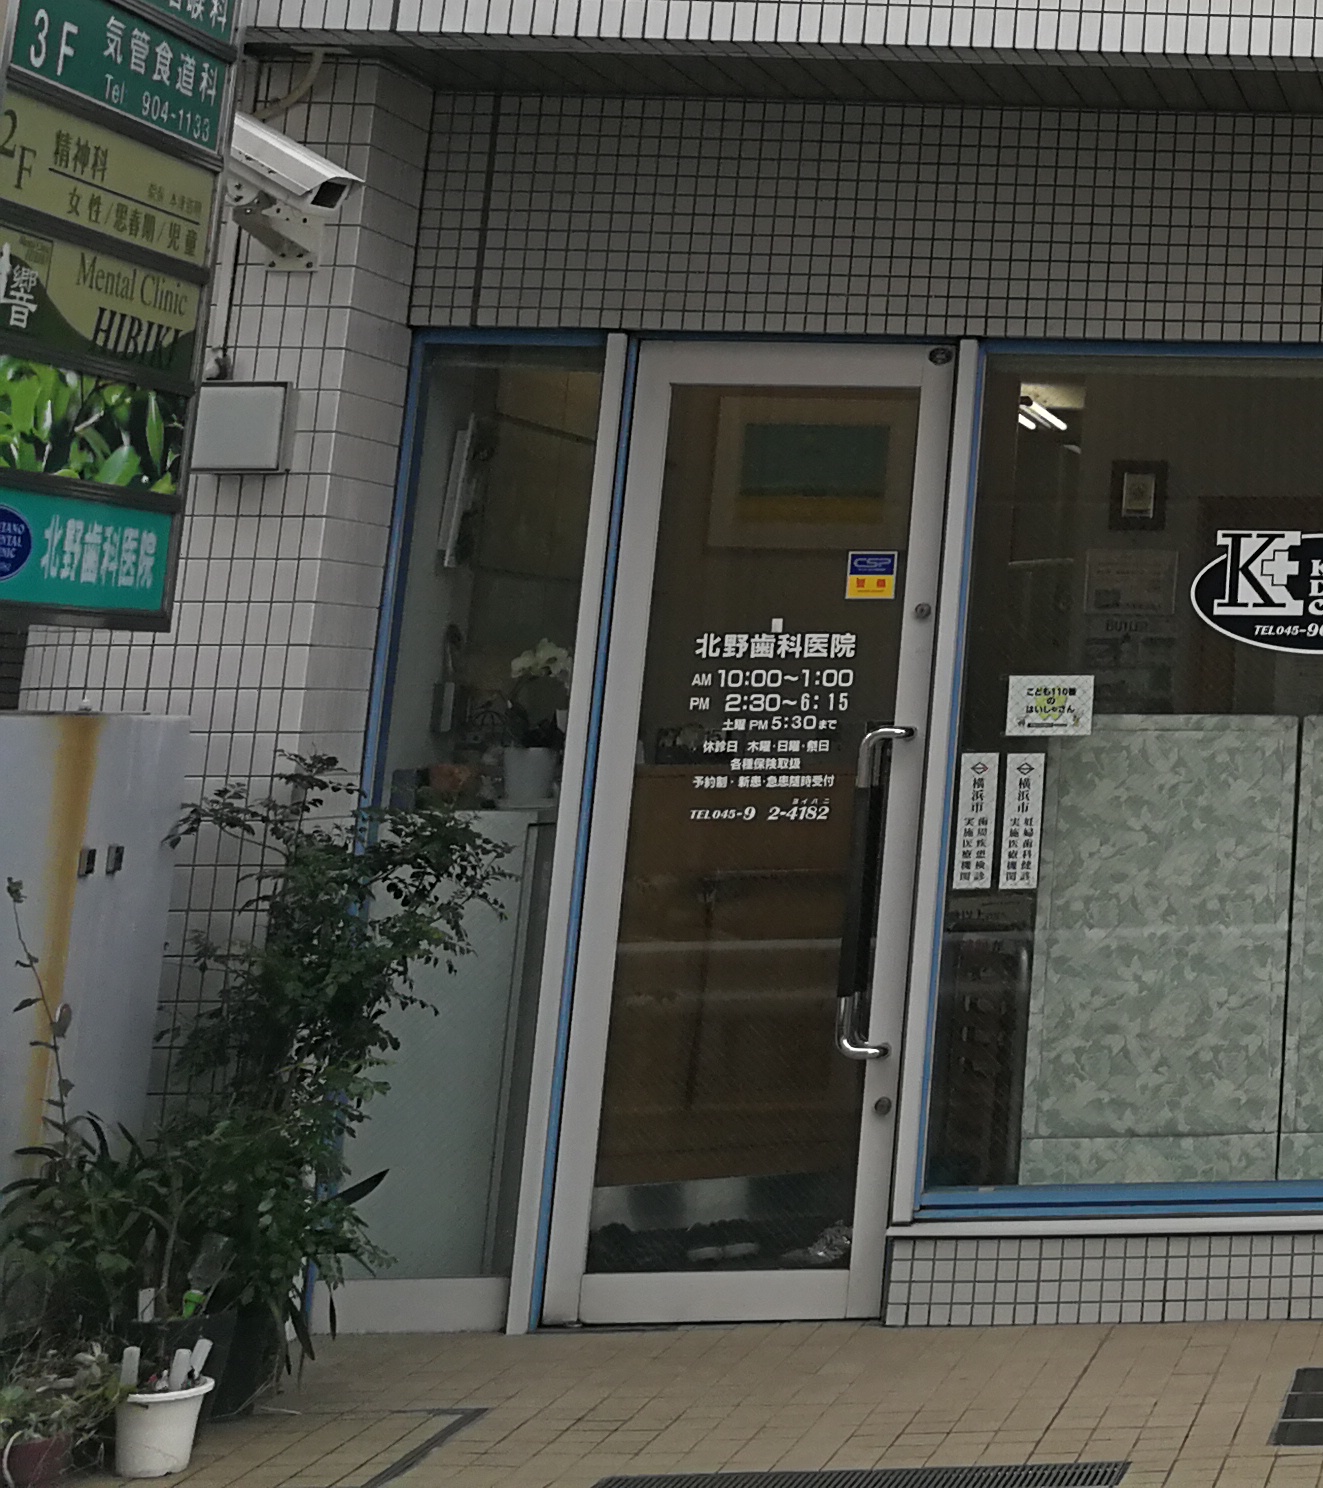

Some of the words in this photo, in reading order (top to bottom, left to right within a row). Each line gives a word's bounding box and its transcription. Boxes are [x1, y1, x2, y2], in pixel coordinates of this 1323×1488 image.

[29, 8, 79, 77] 3F
[103, 15, 219, 107] 気管食道科
[142, 91, 210, 142] 904-1133
[54, 129, 109, 182] 精神科
[8, 263, 40, 329] 響
[76, 251, 137, 302] Mental
[140, 273, 189, 317] Clinic
[89, 306, 184, 368] HIBIKI
[40, 514, 158, 589] 北野歯科医院
[695, 632, 857, 660] 北野歯科医院
[691, 673, 713, 687] AM
[1046, 697, 1056, 705] の
[689, 696, 711, 711] PM
[722, 718, 746, 731] 土曜
[749, 719, 769, 731] PM
[971, 777, 985, 814] 横浜市
[1017, 777, 1031, 814] 横浜市
